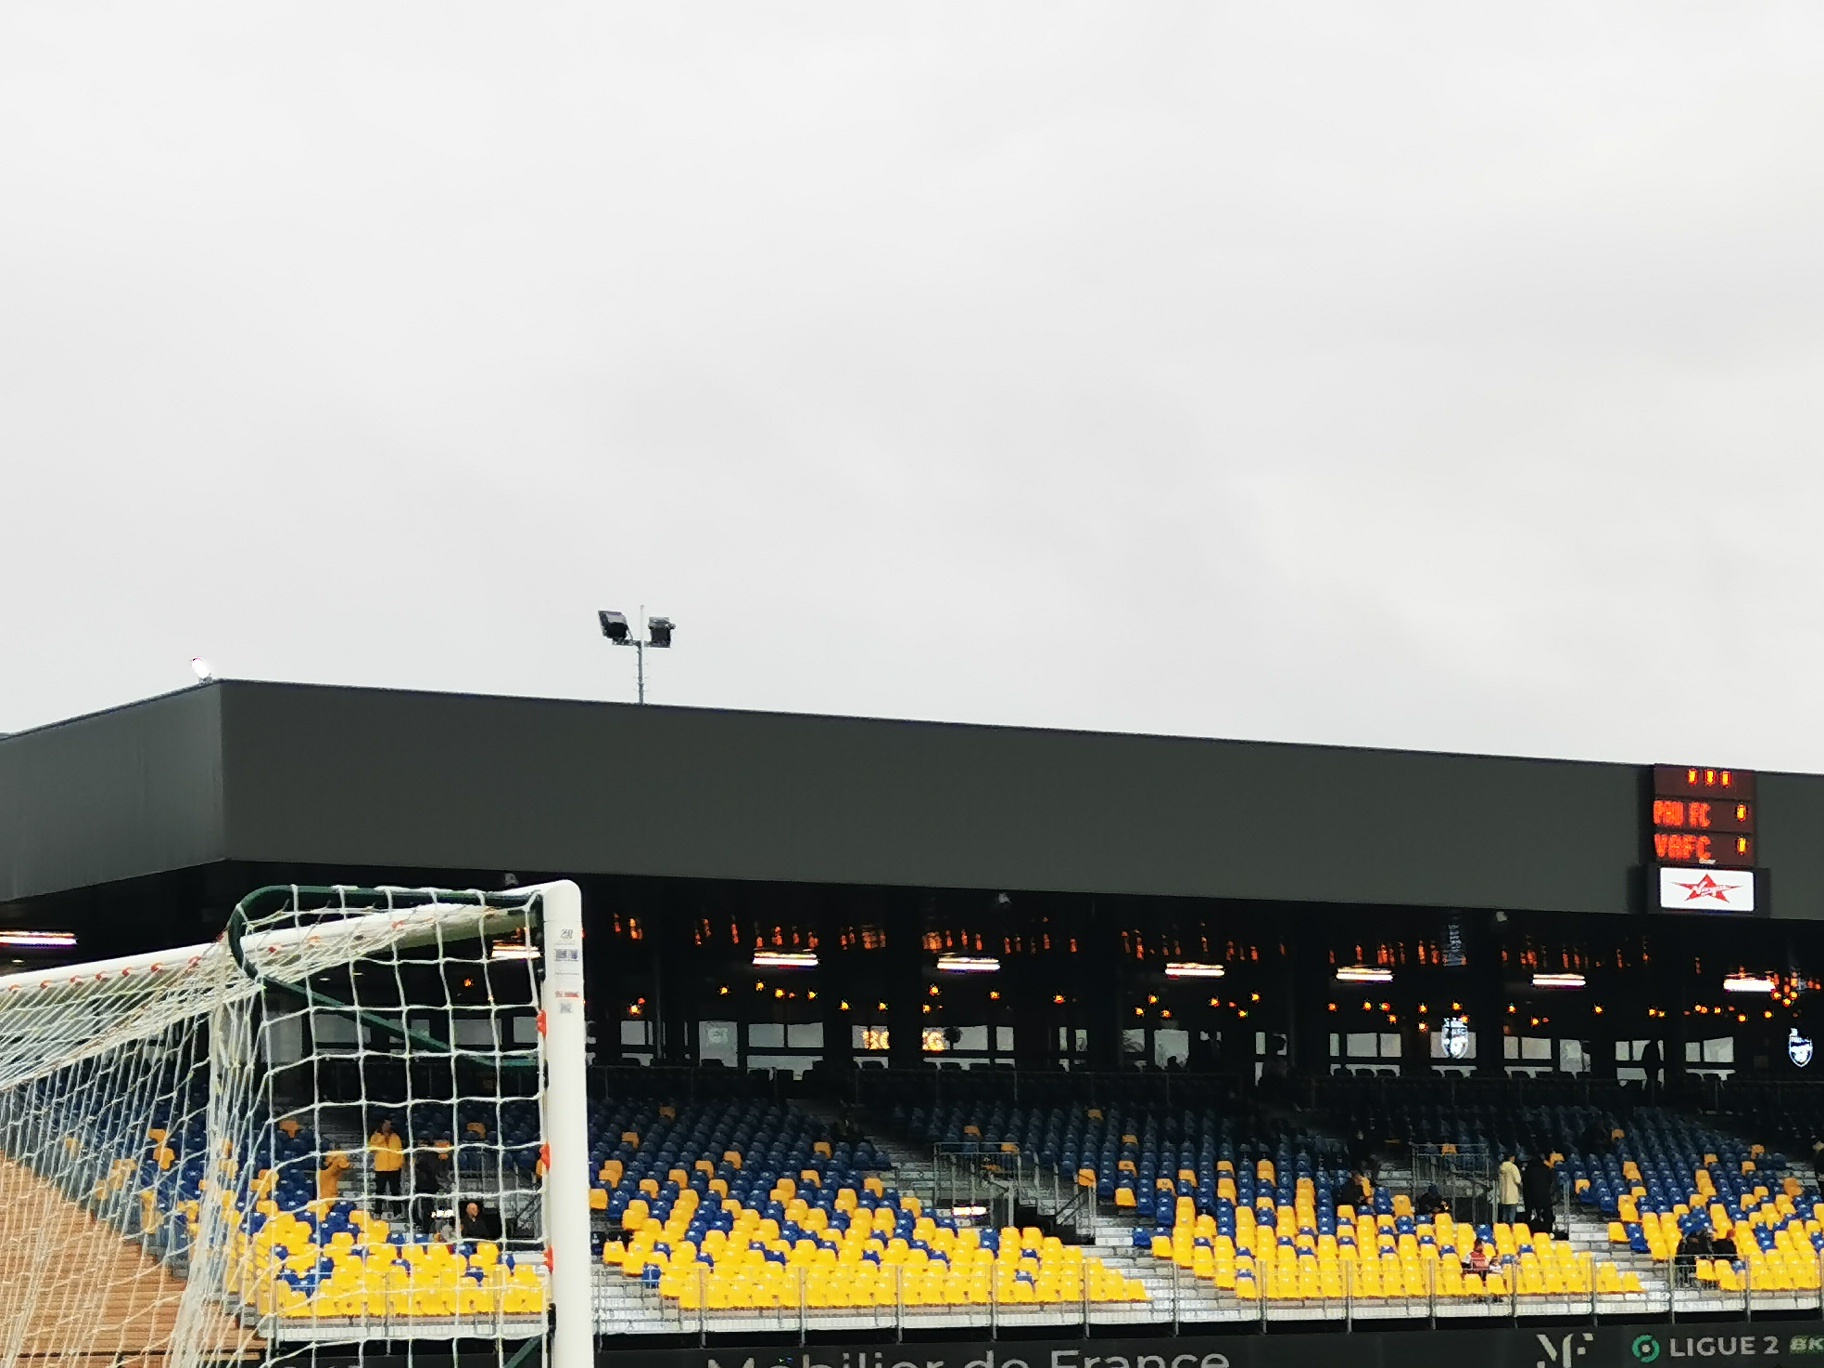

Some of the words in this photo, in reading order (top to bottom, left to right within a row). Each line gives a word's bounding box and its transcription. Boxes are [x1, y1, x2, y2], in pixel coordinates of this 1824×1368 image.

[1688, 801, 1711, 828] FC
[1653, 833, 1712, 861] VAFC
[1669, 1336, 1756, 1357] LIGUE
[1763, 1336, 1780, 1355] 2
